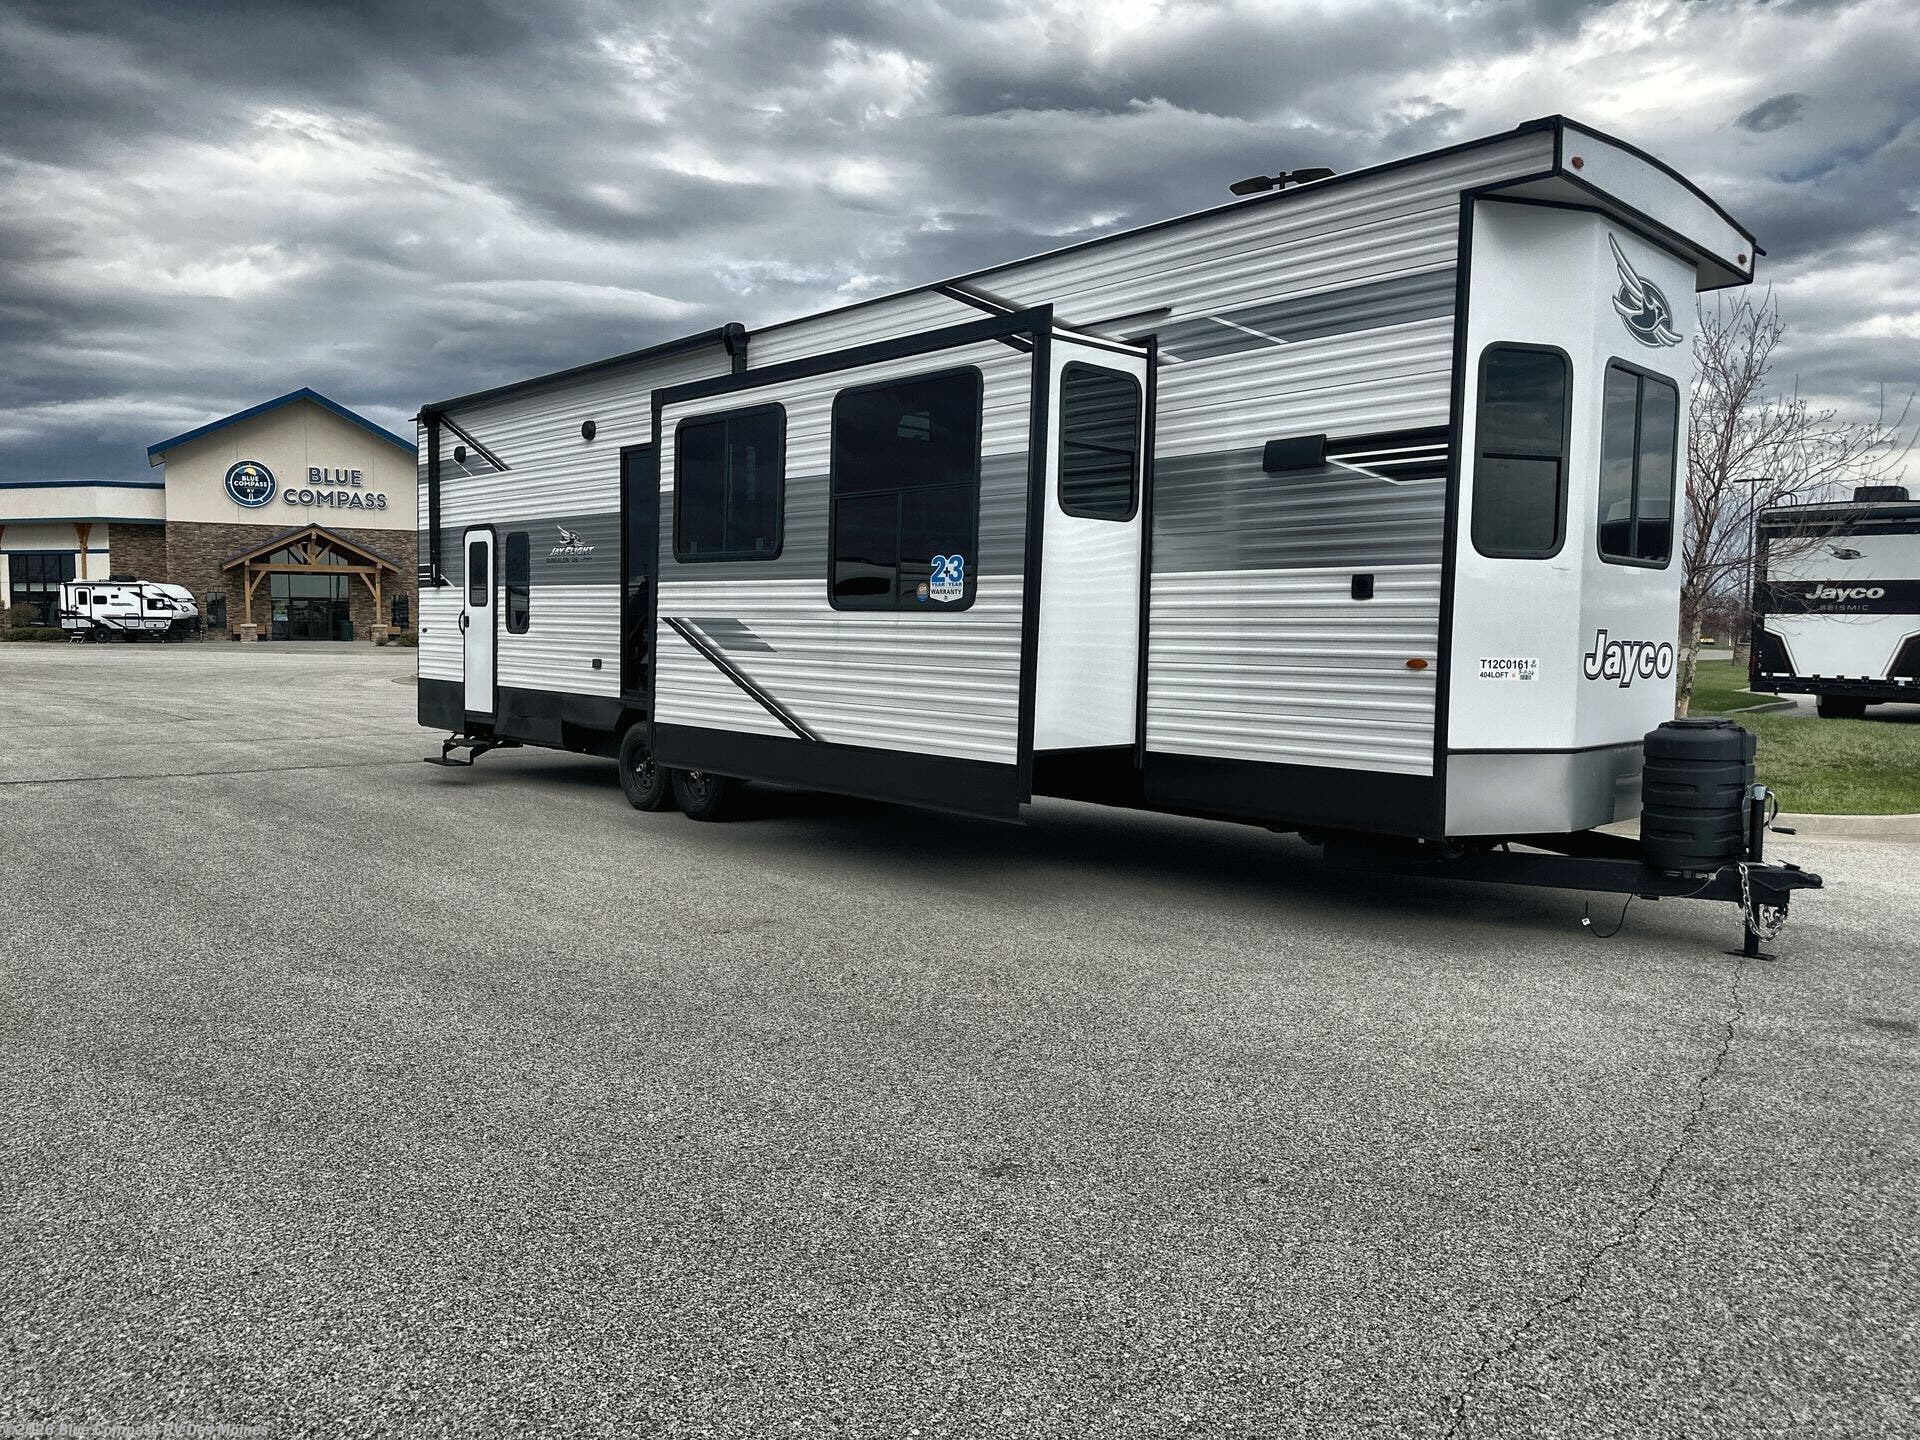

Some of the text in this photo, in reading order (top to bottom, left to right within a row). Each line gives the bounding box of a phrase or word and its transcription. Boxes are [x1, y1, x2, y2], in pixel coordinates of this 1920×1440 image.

[233, 480, 268, 488] COMPASS
[308, 467, 362, 487] BLUE
[283, 488, 388, 509] COMPASS
[1805, 584, 1885, 603] Jayco
[1480, 659, 1529, 670] T12C0161
[1583, 628, 1674, 689] Jayco
[1479, 671, 1509, 679] 404LOFT
